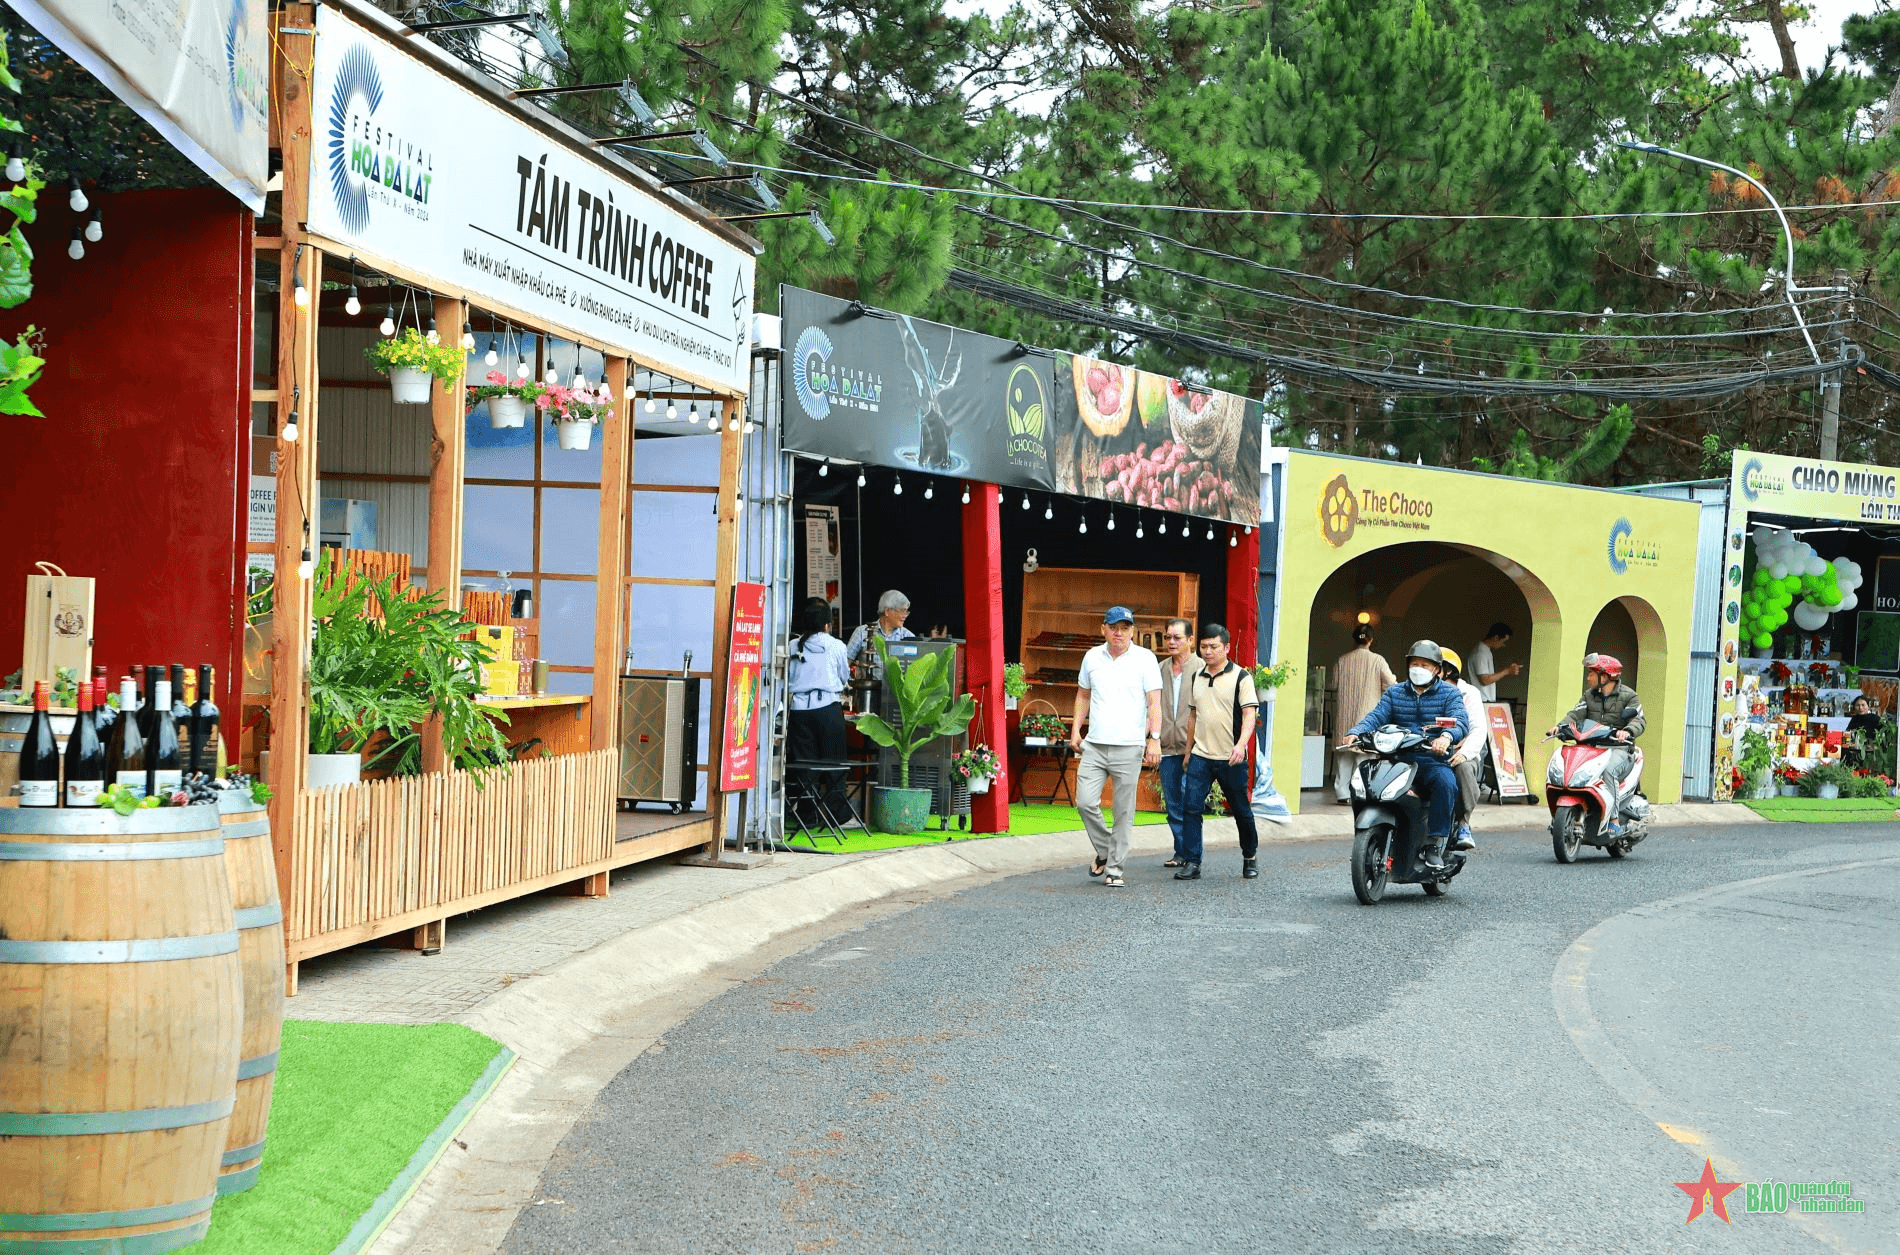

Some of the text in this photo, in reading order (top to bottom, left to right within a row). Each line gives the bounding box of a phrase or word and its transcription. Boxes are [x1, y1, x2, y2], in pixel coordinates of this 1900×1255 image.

[351, 138, 380, 183] HOA
[353, 115, 432, 171] FESTIVAL
[516, 153, 713, 320] TÁM TRÌNH COFFEE
[462, 247, 478, 269] NHÀ
[479, 252, 494, 274] MÁY
[493, 258, 511, 282] XUẤT
[511, 267, 528, 291] NHẬP
[529, 271, 546, 296] KHẨU
[545, 280, 554, 300] CÀ
[555, 285, 567, 305] PHÊ
[599, 303, 614, 322] RANG
[614, 307, 622, 326] CÀ
[622, 312, 632, 329] PHÊ
[642, 320, 653, 336] KHU
[652, 324, 660, 340] DU
[659, 327, 671, 345] LỊCH
[811, 360, 882, 385] FESTIVAL
[811, 371, 839, 394] HOA
[1791, 463, 1896, 499] CHÀO MỪNG
[1362, 488, 1433, 518] The Choco
[1860, 497, 1883, 520] LẦN
